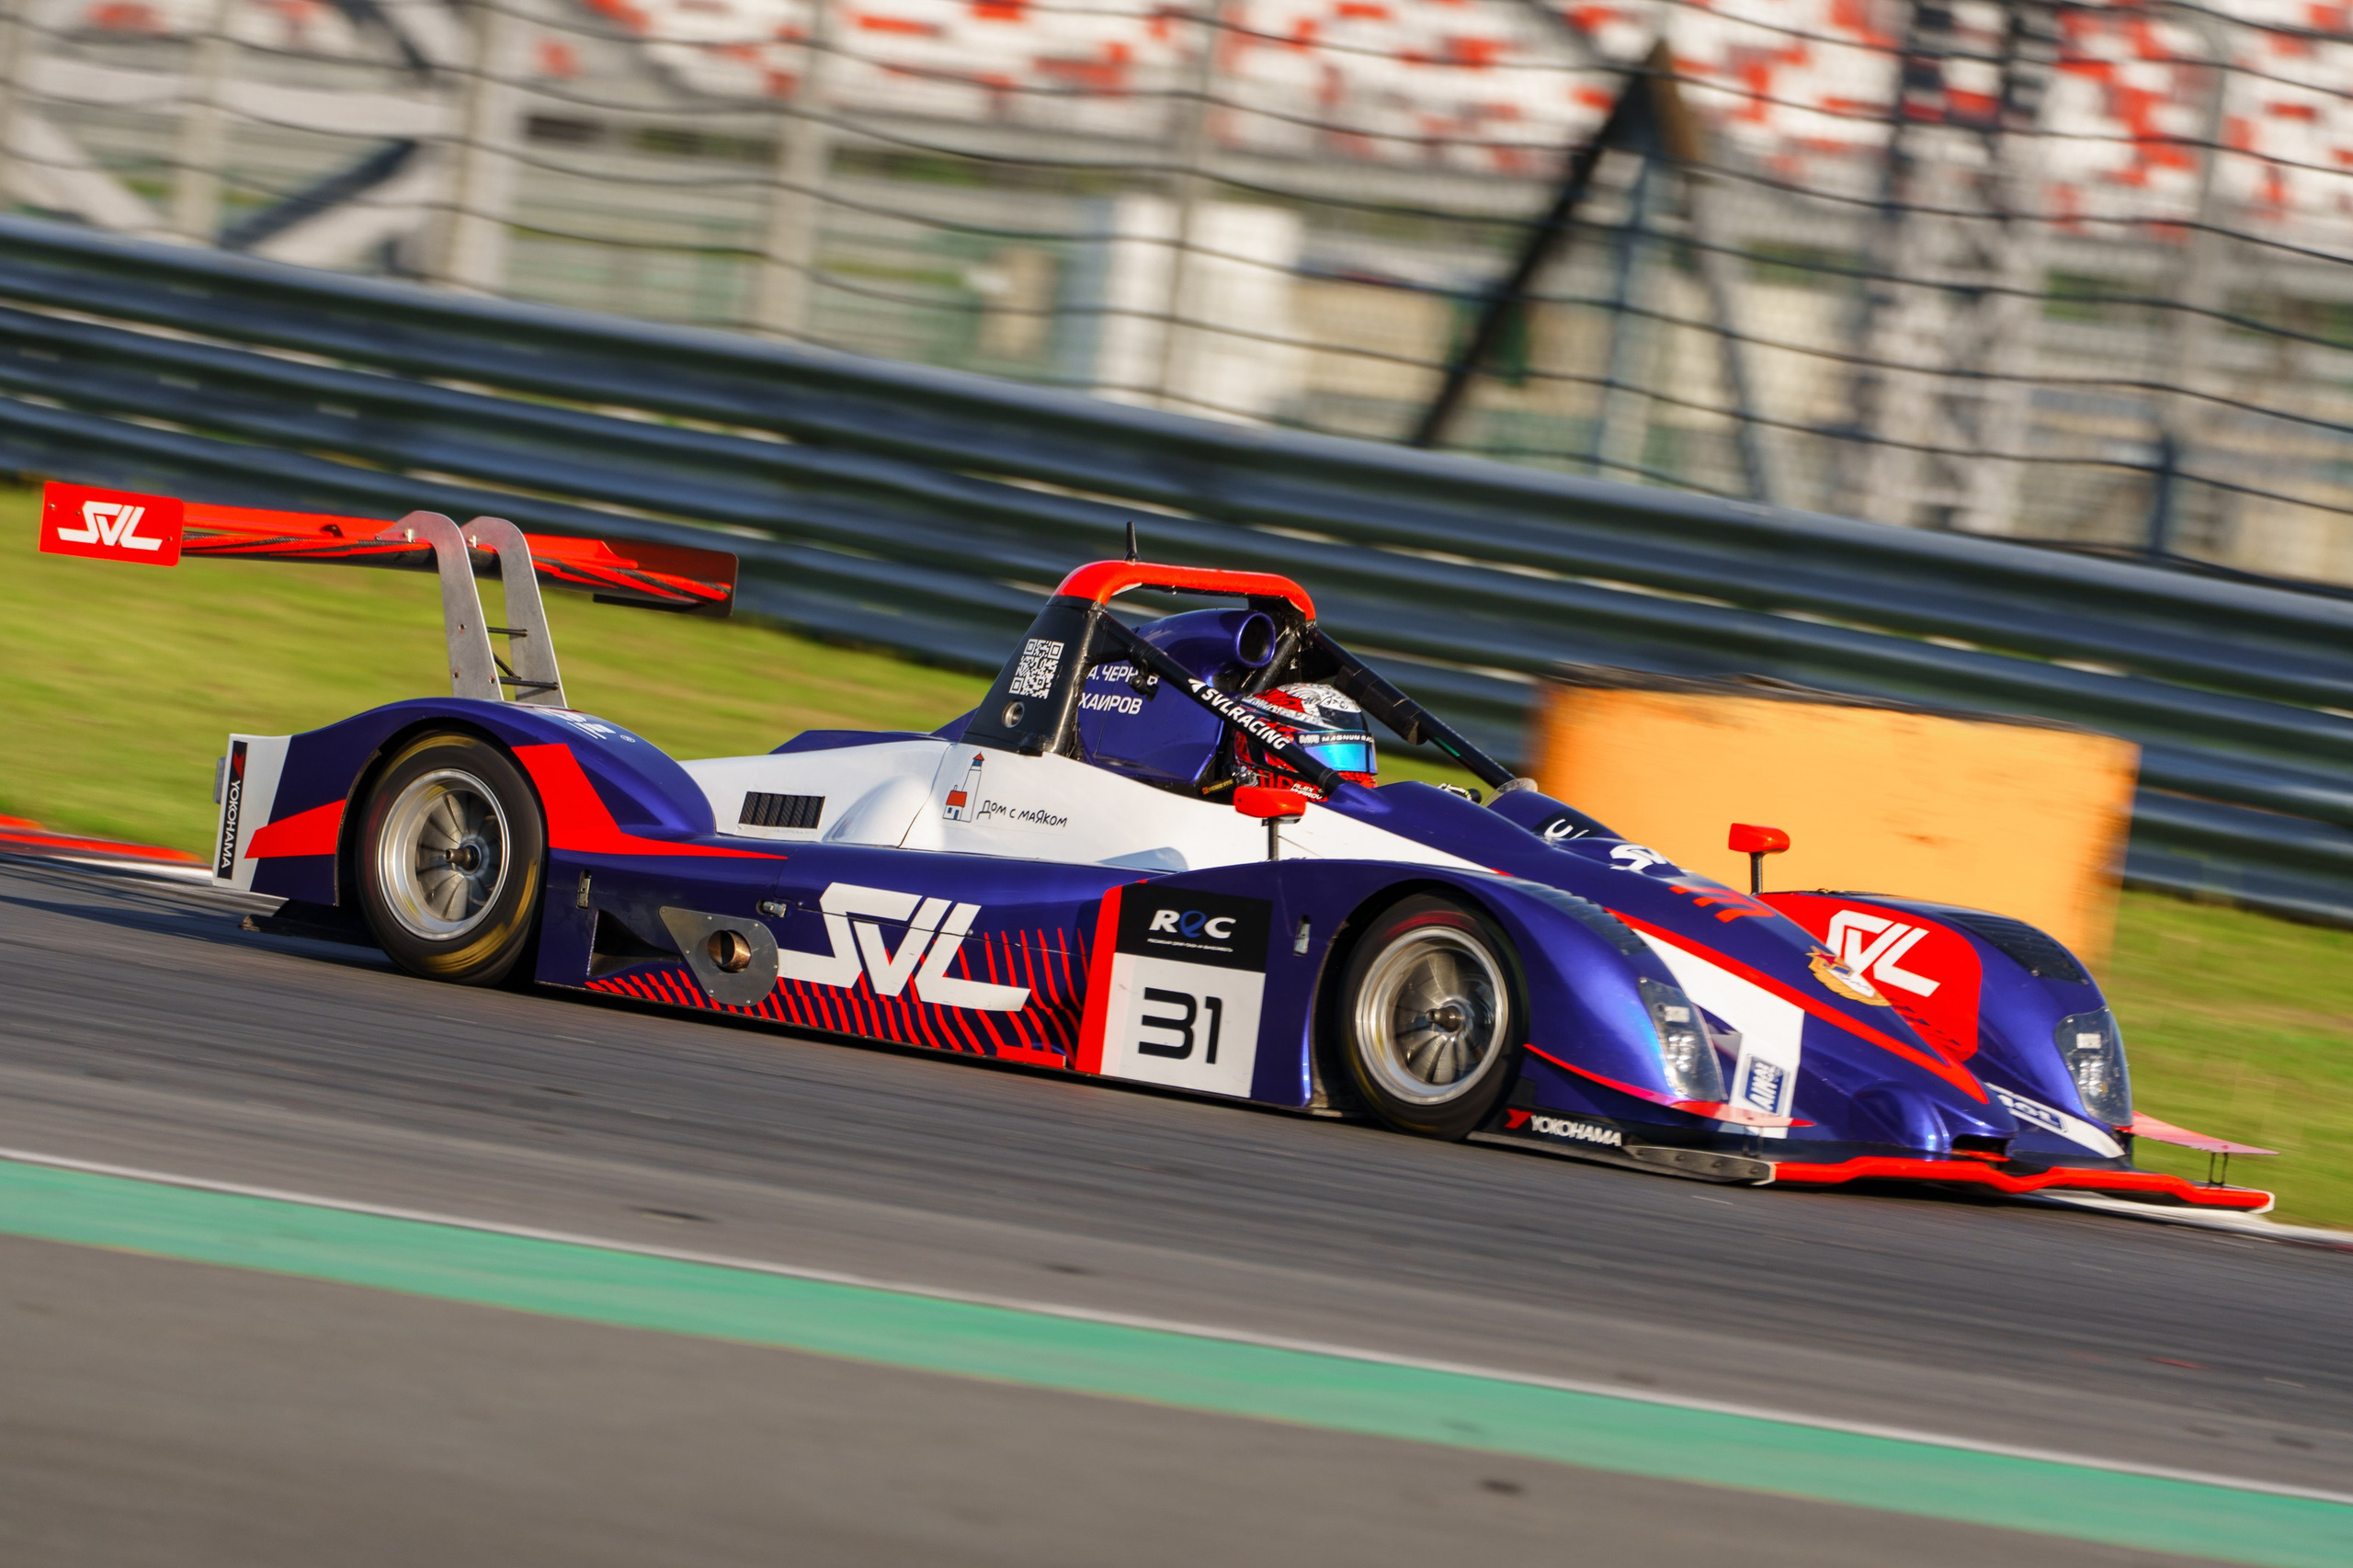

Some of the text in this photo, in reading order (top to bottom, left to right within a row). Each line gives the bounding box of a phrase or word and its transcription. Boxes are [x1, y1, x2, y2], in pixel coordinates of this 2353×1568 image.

[57, 500, 164, 551] SVL
[1077, 692, 1143, 715] ХАИРОВ
[222, 779, 242, 869] YOKOHAMA
[778, 881, 1031, 1011] SVL
[1138, 986, 1222, 1064] 31
[1530, 1115, 1622, 1147] YOKOHAMA
